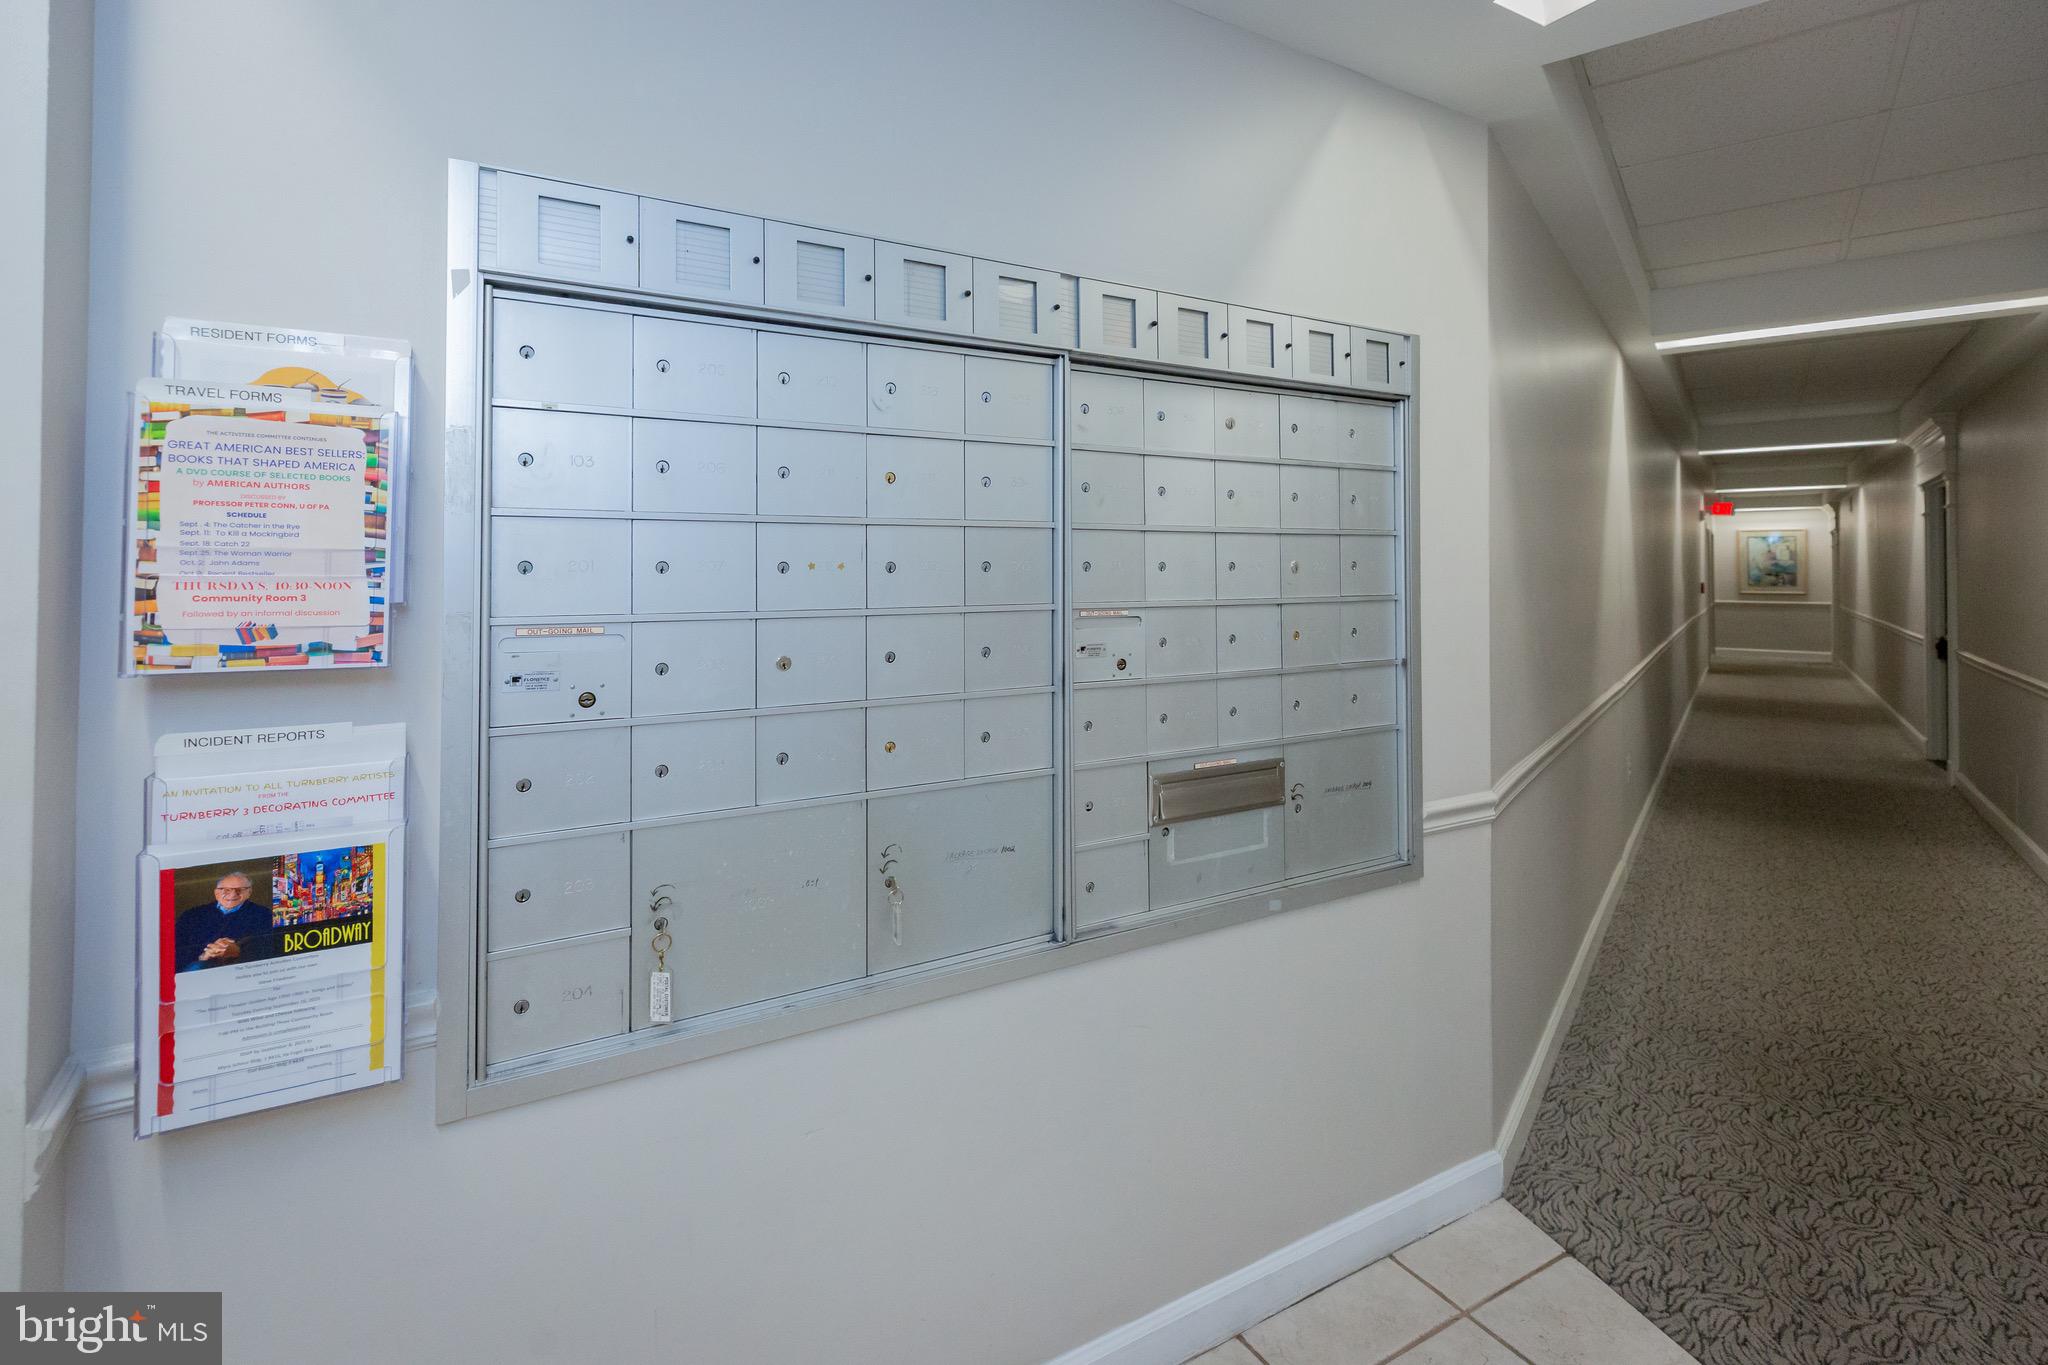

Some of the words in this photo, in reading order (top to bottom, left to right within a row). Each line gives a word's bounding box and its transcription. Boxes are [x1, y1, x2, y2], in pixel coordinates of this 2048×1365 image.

[190, 326, 262, 342] RESIDENT
[266, 332, 318, 346] FORMS
[165, 384, 225, 399] TRAVEL
[230, 389, 282, 403] FORMS
[168, 440, 210, 450] GREAT
[215, 442, 282, 454] AMERICAN
[285, 446, 315, 456] BEST
[317, 448, 366, 459] SELLERS:
[168, 454, 213, 464] BOOKS
[219, 456, 249, 466] THAT
[252, 458, 300, 469] SHAPED
[304, 461, 356, 471] AMERICA
[570, 455, 594, 468] 103
[192, 479, 204, 488] by
[207, 480, 260, 488] AMERICAN
[264, 482, 311, 490] AUTHORS
[211, 469, 251, 478] COURSE
[270, 471, 316, 480] SELECTED
[320, 473, 351, 482] BOOKS
[568, 560, 594, 573] 201
[192, 594, 262, 604] Community
[226, 610, 238, 619] by
[183, 734, 252, 748] INCIDENT
[257, 729, 325, 743] REPORTS
[162, 790, 178, 798] AN
[182, 785, 242, 797] INVITATION
[264, 781, 283, 790] ALL
[287, 776, 348, 788] TURNBERRY
[352, 771, 395, 782] ARTISTS
[161, 808, 240, 822] TURNBERRY
[243, 807, 249, 816] 3
[253, 799, 328, 815] DECORATING
[332, 792, 396, 807] COMMITTEE
[284, 921, 371, 953] BROADWAY
